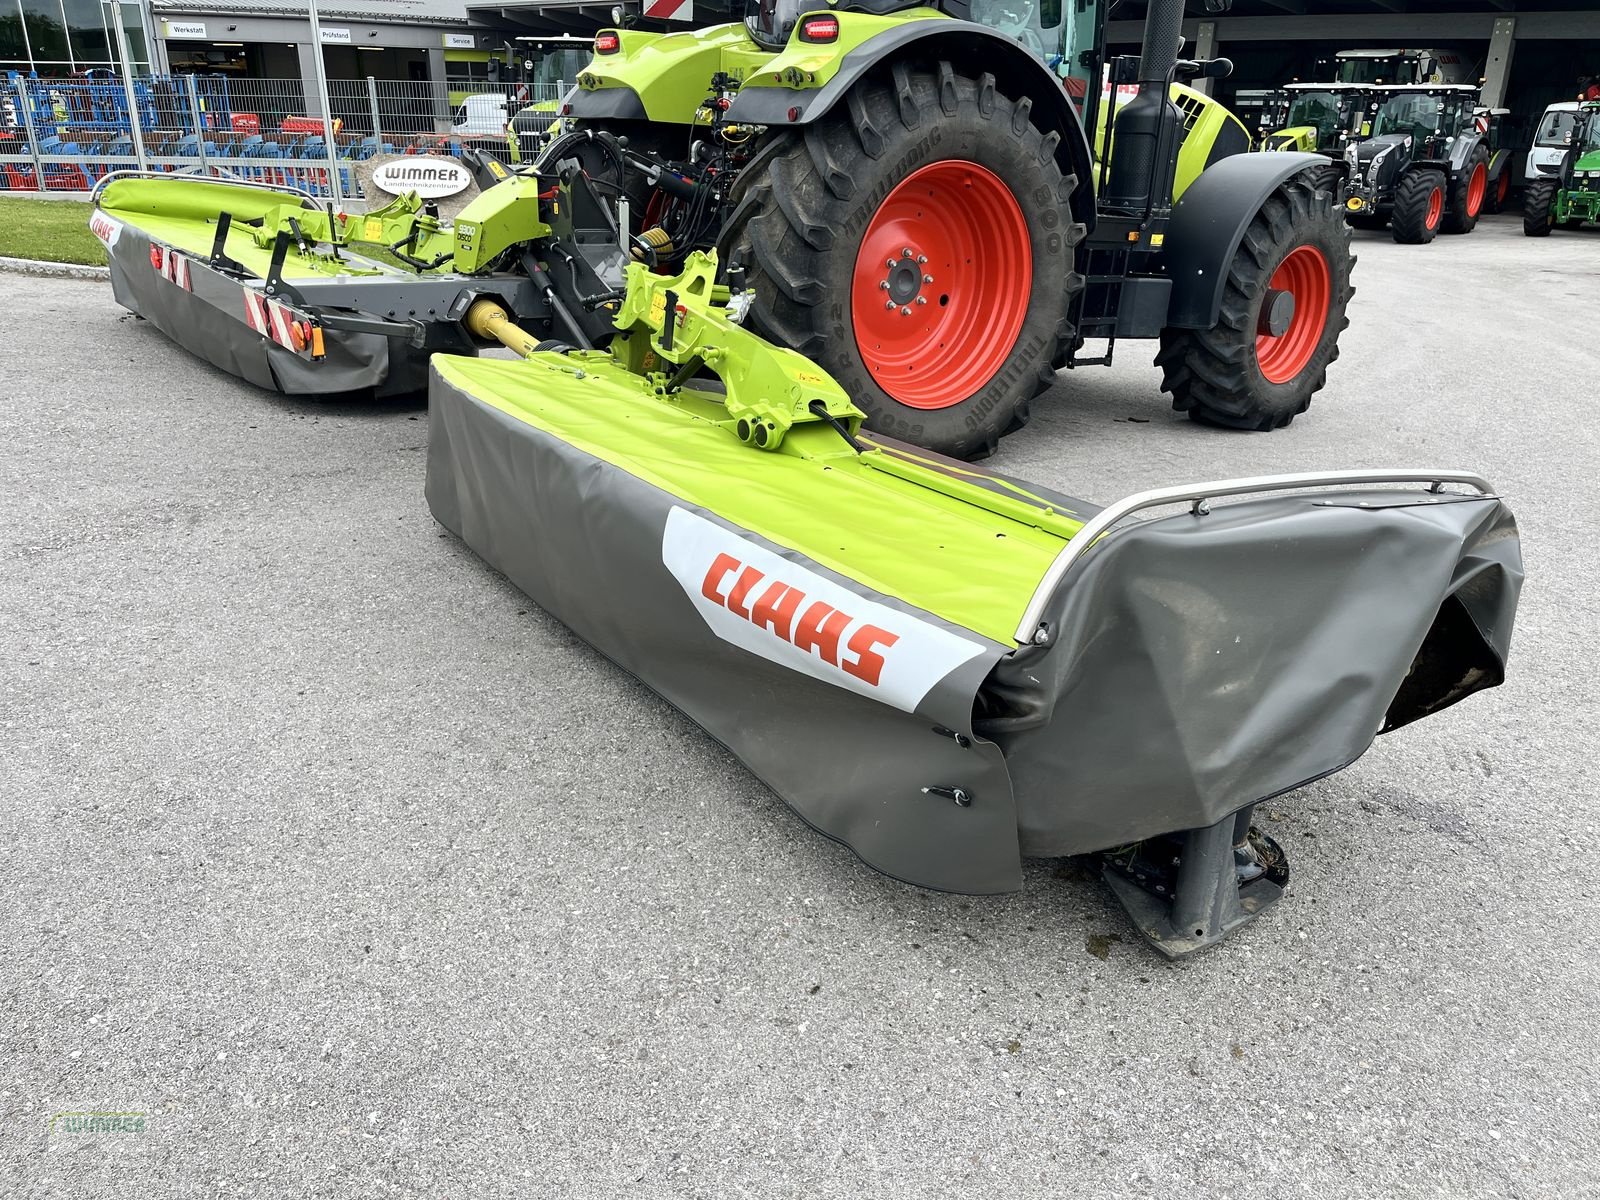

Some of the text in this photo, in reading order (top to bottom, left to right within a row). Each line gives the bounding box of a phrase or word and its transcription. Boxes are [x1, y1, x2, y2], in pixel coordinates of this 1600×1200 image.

[174, 26, 204, 34] Werkstatt
[322, 31, 349, 39] Prüfstand
[452, 37, 471, 45] Service
[385, 167, 459, 181] WIMMER
[383, 180, 459, 189] Landtechnikzentrum
[844, 126, 942, 238] TRELLEBORG
[92, 217, 115, 243] CLAAS
[964, 335, 1047, 433] TRELLEBORG
[701, 552, 900, 687] CLAAS
